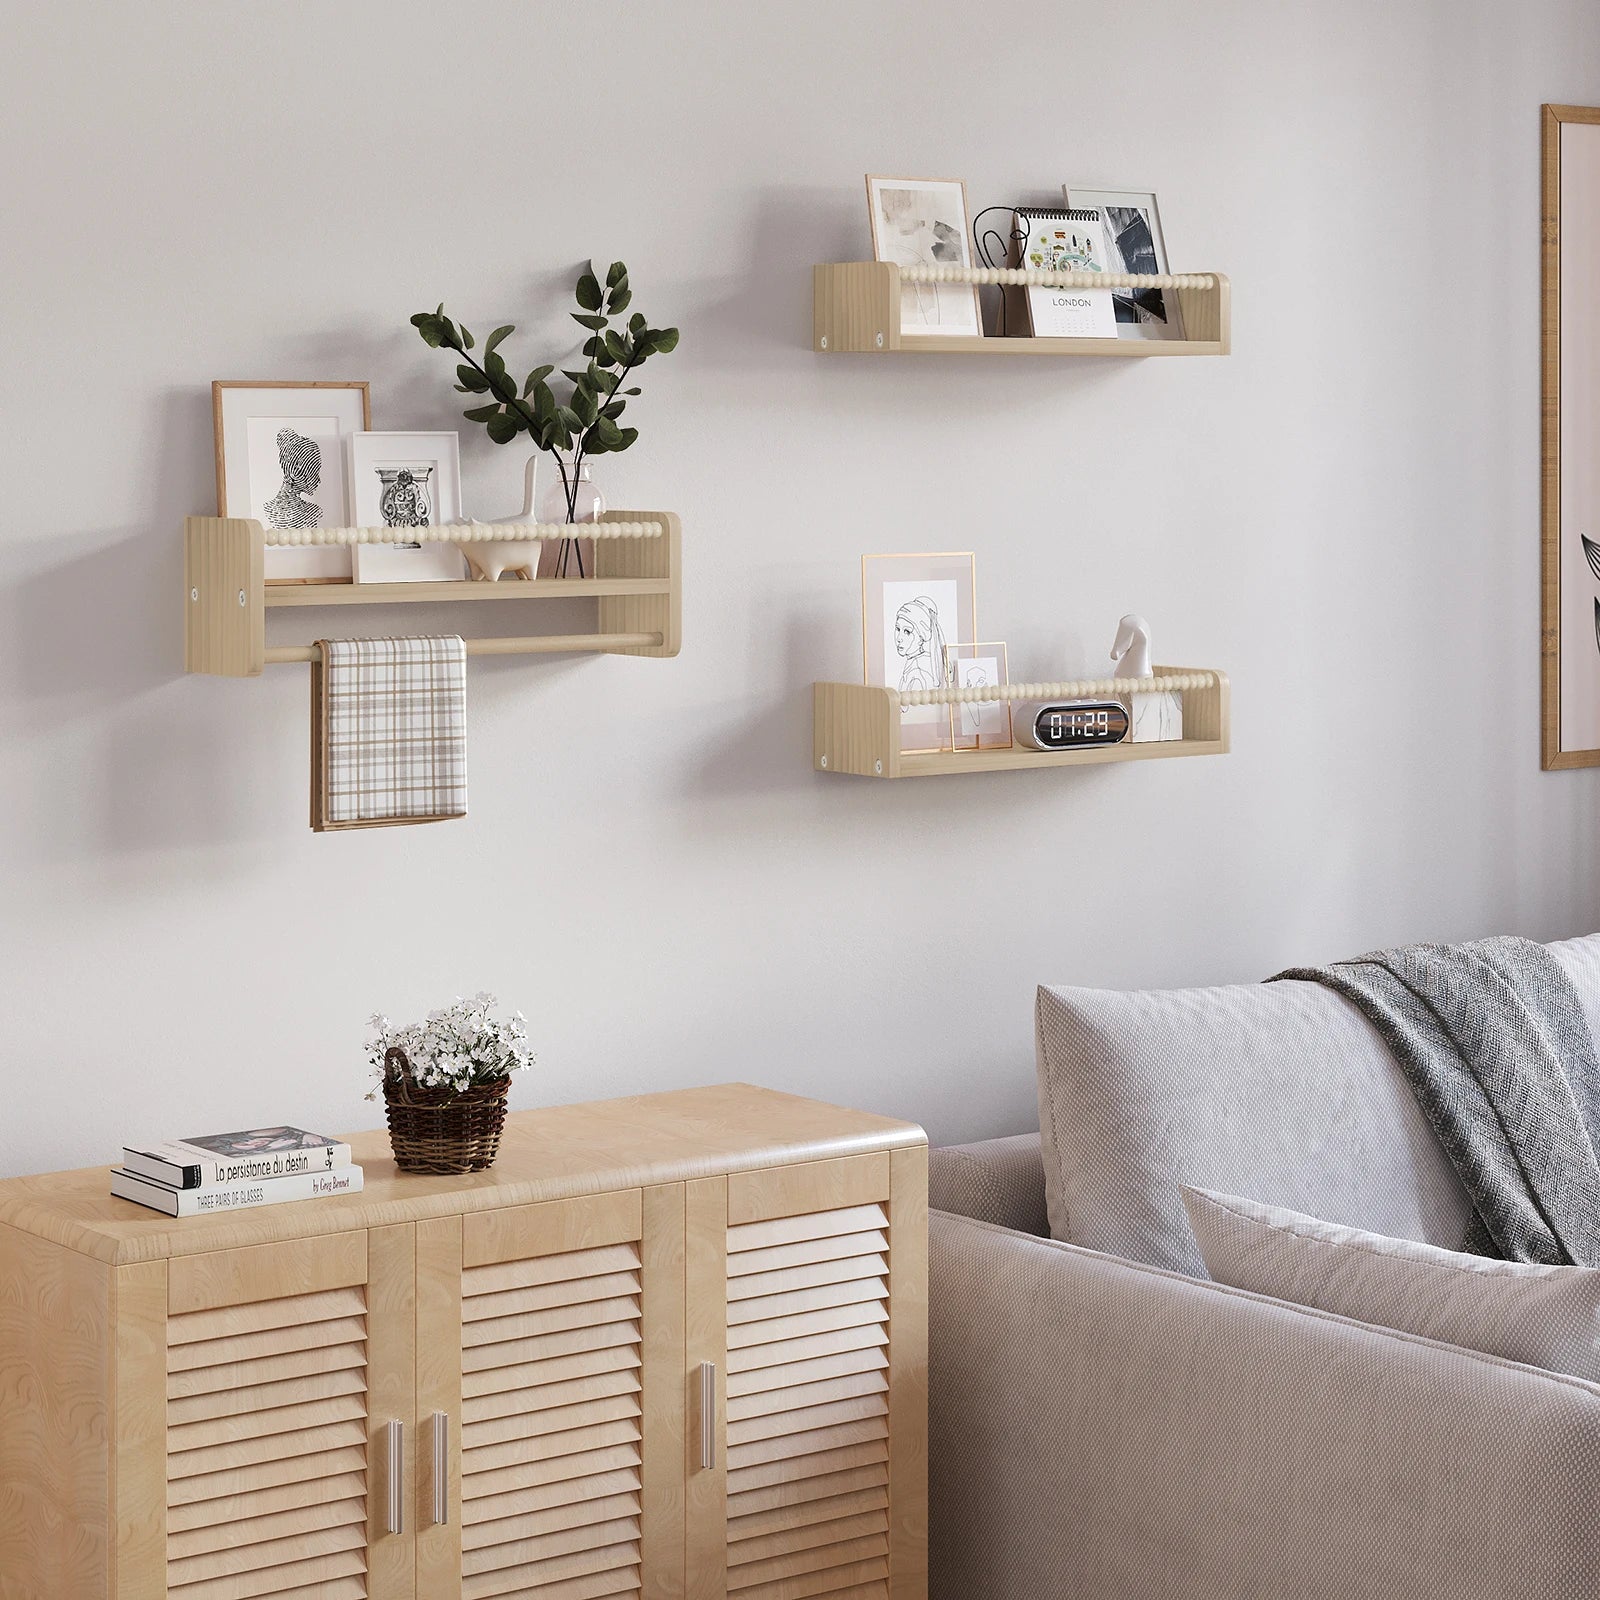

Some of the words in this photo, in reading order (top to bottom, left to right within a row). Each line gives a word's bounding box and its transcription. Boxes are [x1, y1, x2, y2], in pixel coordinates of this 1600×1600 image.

[1052, 298, 1091, 307] LONDON
[1050, 711, 1108, 739] 01:29
[214, 1162, 225, 1182] La
[226, 1159, 271, 1184] persistance
[272, 1154, 284, 1174] du
[285, 1151, 309, 1172] destin
[312, 1178, 319, 1194] by
[197, 1194, 214, 1209] THREE
[215, 1192, 231, 1207] PAIRS
[232, 1191, 239, 1205] OF
[240, 1187, 264, 1203] GLASSES
